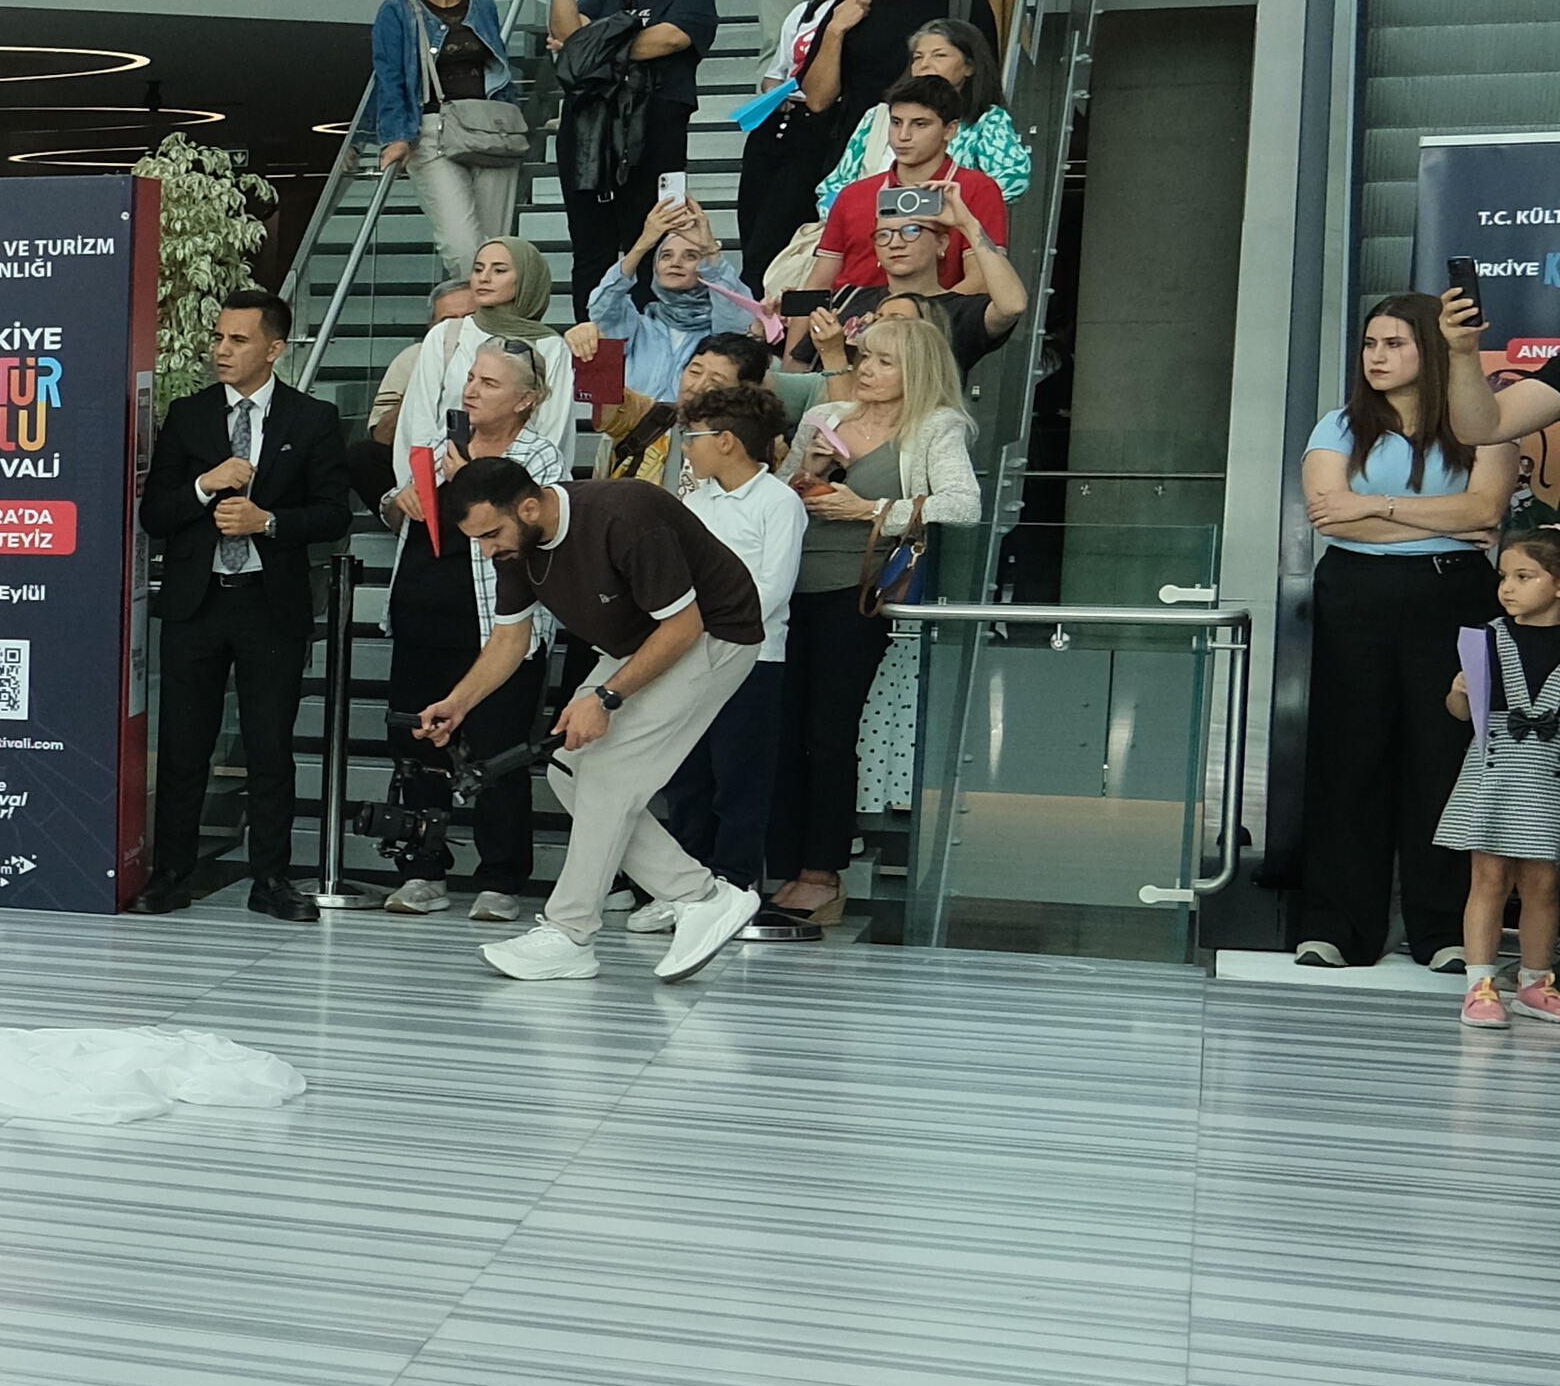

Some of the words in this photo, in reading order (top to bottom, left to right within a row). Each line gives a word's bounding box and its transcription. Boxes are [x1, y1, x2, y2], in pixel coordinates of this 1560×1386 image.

[1478, 211, 1512, 225] T.C.
[4, 241, 29, 256] VE
[35, 235, 114, 256] TURİZM
